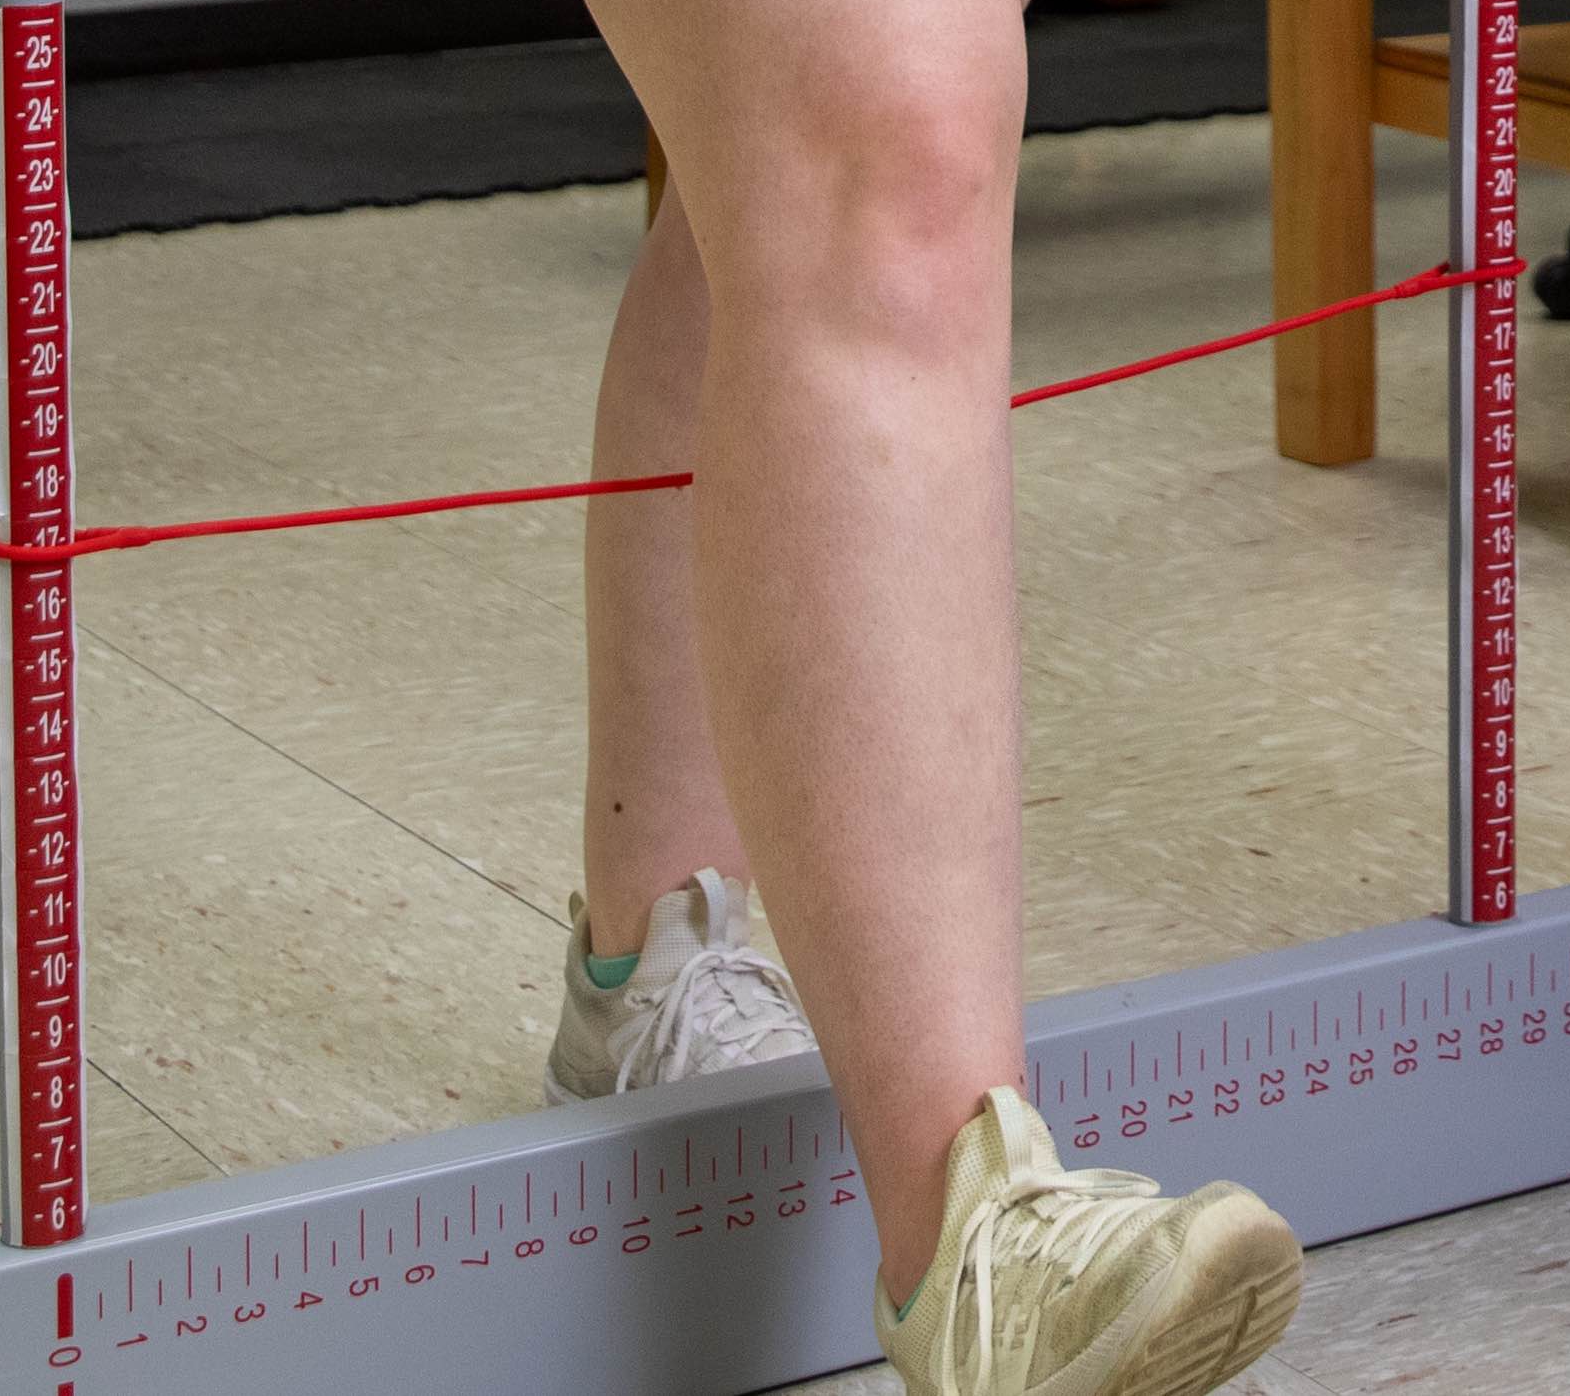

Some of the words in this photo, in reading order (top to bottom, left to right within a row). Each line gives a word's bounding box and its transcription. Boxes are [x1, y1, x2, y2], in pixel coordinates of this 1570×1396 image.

[1495, 14, 1514, 44] 23
[26, 34, 52, 70] 25
[1495, 65, 1514, 96] 22
[27, 96, 53, 131] 24
[1495, 117, 1513, 146] 21
[29, 157, 54, 193] 23
[1494, 167, 1513, 197] 20
[30, 219, 55, 254] 22
[1495, 219, 1512, 248] 19
[32, 280, 55, 315] 21
[1494, 321, 1511, 351] 17
[31, 341, 57, 377] 20
[1493, 372, 1511, 401] 16
[34, 403, 58, 437] 19
[1492, 423, 1511, 453] 15
[35, 464, 59, 499] 18
[1493, 475, 1511, 504] 14
[36, 525, 59, 547] 17
[1492, 525, 1511, 554] 13
[37, 586, 60, 621] 16
[1492, 576, 1511, 605] 12
[1494, 627, 1511, 656] 11
[38, 648, 62, 683] 15
[1492, 677, 1511, 706] 10
[39, 708, 62, 744] 14
[1496, 729, 1507, 758] 9
[40, 770, 63, 805] 13
[1495, 780, 1507, 808] 8
[41, 831, 64, 866] 12
[1495, 830, 1506, 858] 7
[44, 891, 64, 926] 11
[1495, 881, 1507, 909] 6
[43, 952, 67, 987] 10
[49, 1015, 62, 1048] 9
[1480, 1019, 1504, 1055] 28
[1523, 1010, 1545, 1045] 29
[1394, 1041, 1417, 1075] 26
[1437, 1030, 1461, 1060] 27
[1304, 1060, 1328, 1096] 24
[1349, 1048, 1375, 1086] 25
[50, 1075, 63, 1109] 8
[1213, 1080, 1240, 1114] 22
[1260, 1069, 1284, 1106] 23
[1121, 1100, 1147, 1138] 20
[1168, 1090, 1194, 1122] 21
[1073, 1113, 1100, 1150] 19
[51, 1135, 64, 1170] 7
[777, 1179, 806, 1218] 13
[831, 1169, 856, 1206] 14
[52, 1196, 65, 1230] 6
[677, 1203, 703, 1237] 11
[725, 1192, 757, 1229] 12
[514, 1238, 545, 1259] 8
[568, 1224, 598, 1246] 9
[621, 1216, 654, 1255] 10
[404, 1264, 436, 1285] 6
[461, 1251, 490, 1266] 7
[294, 1291, 323, 1311] 4
[349, 1276, 381, 1299] 5
[176, 1315, 208, 1336] 2
[233, 1303, 267, 1325] 3
[47, 1345, 83, 1370] 0
[118, 1334, 149, 1349] 1
